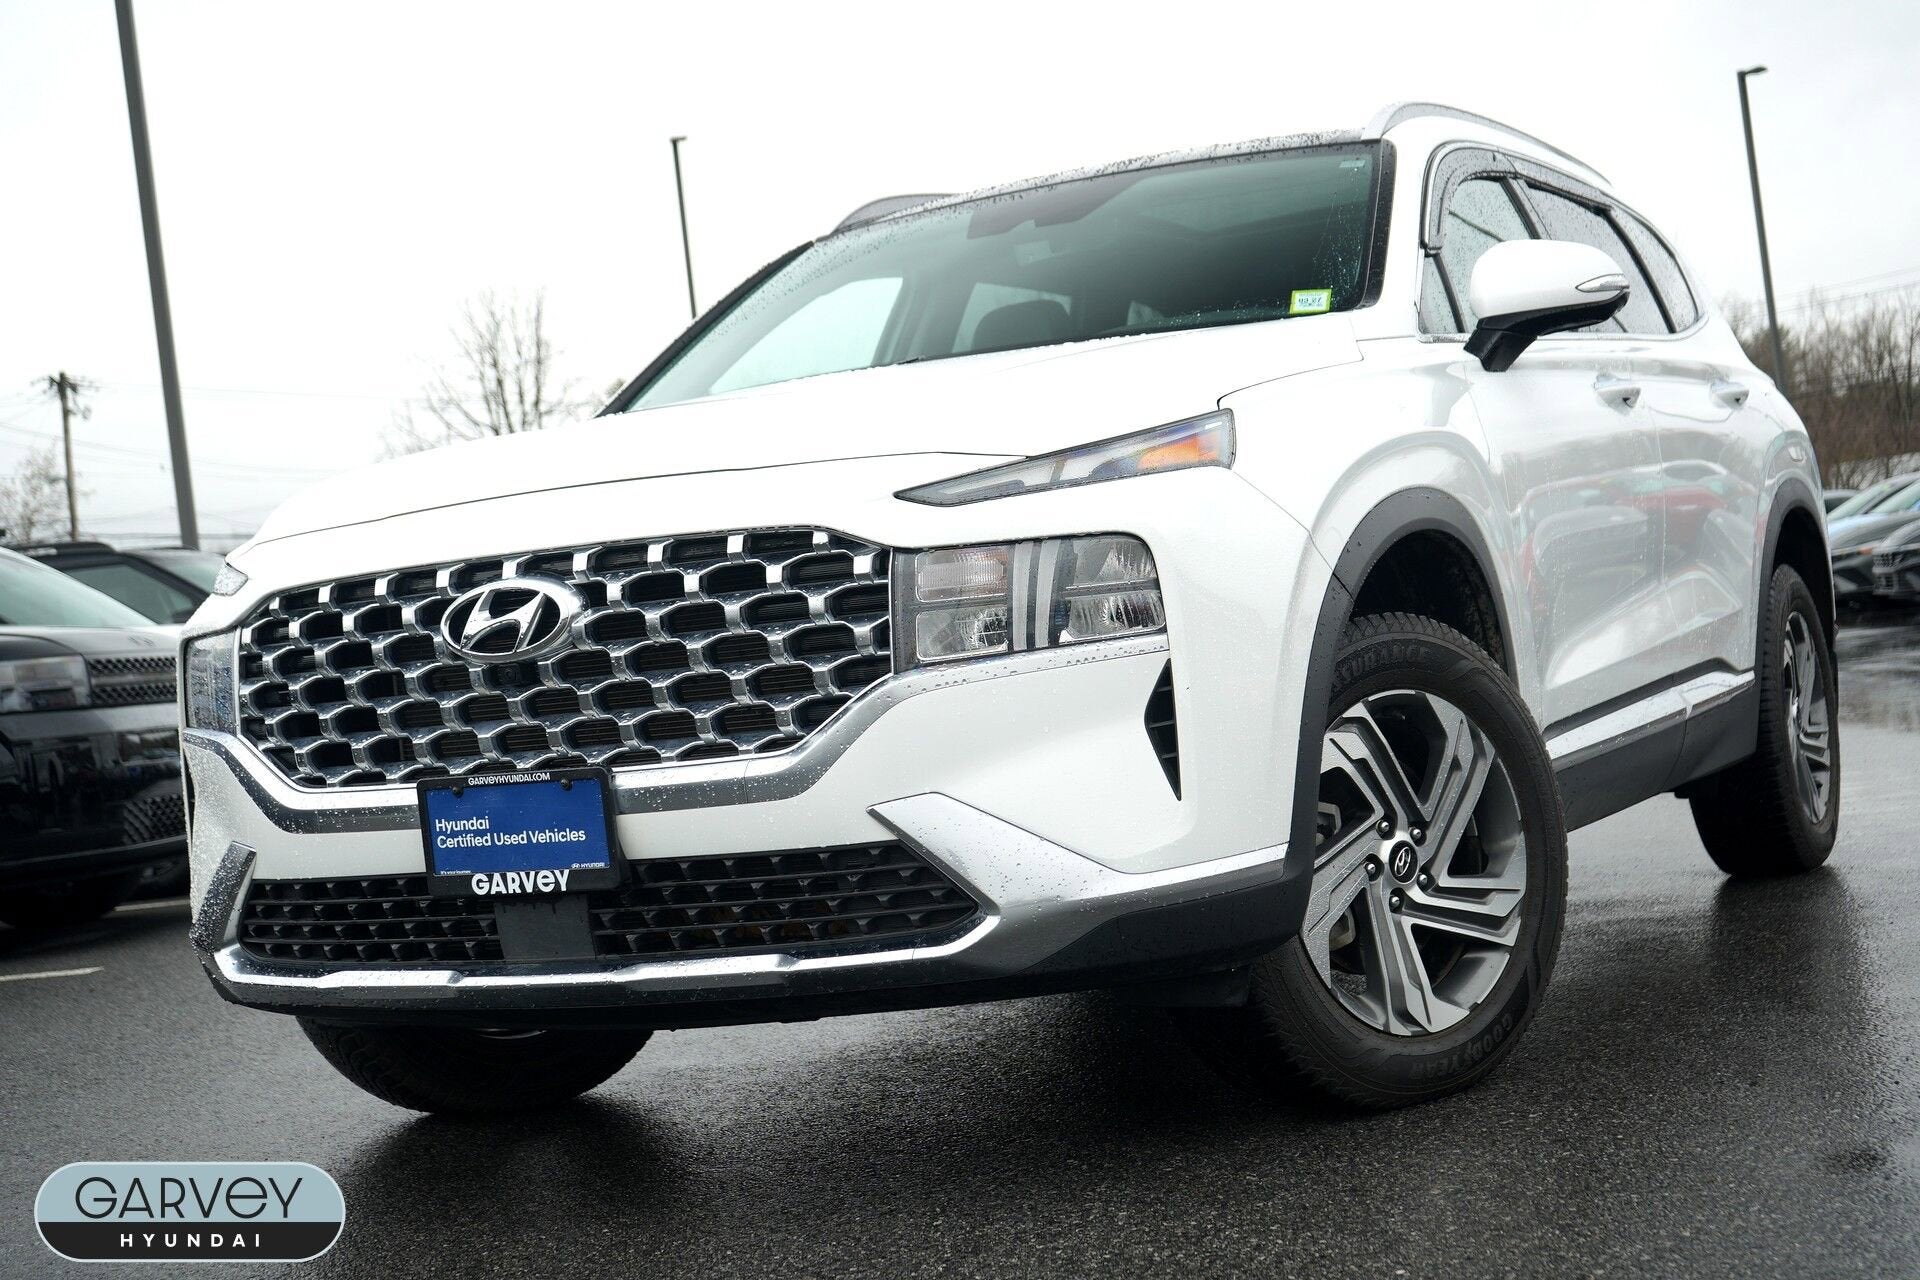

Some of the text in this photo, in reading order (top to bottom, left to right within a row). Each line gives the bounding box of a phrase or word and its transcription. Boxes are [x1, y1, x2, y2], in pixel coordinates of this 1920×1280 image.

[435, 816, 490, 834] Hyundai
[437, 828, 586, 849] Certified Used Vehicles
